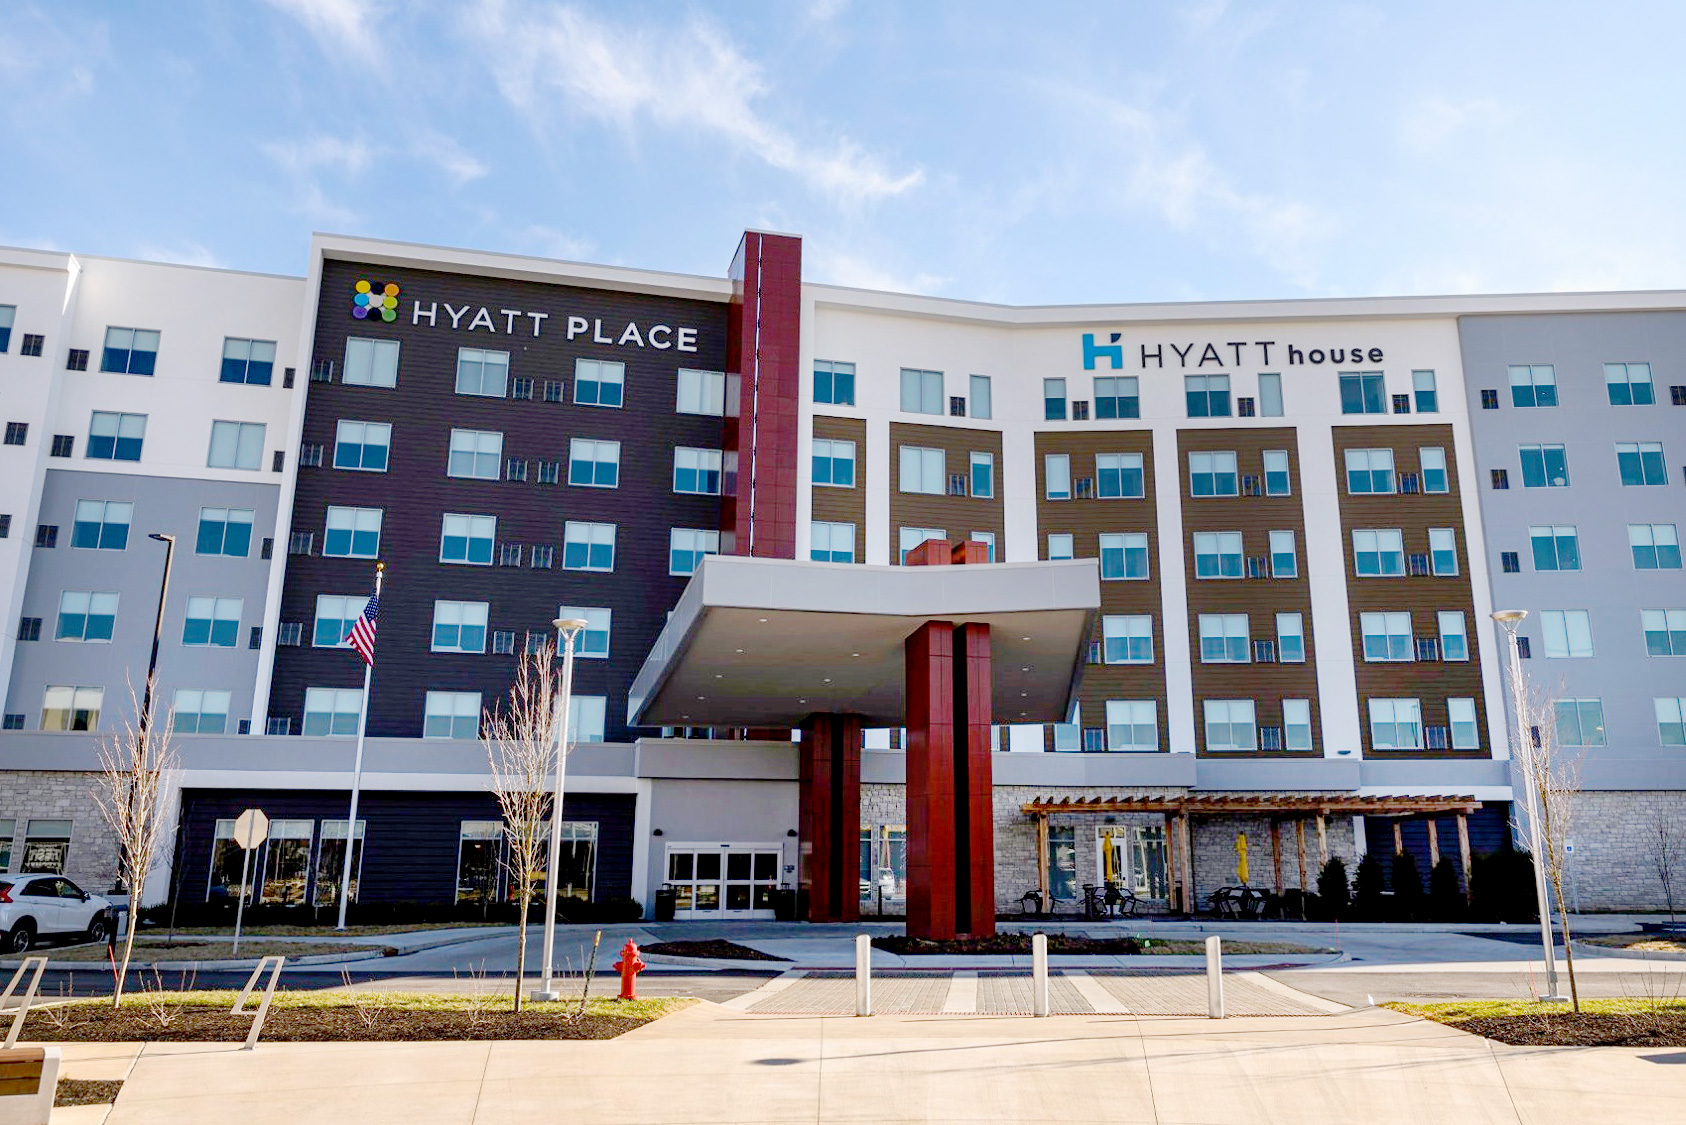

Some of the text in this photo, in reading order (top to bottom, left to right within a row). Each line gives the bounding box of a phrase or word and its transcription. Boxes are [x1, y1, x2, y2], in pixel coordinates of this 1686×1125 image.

[412, 300, 699, 353] HYATT PLACE
[1140, 341, 1385, 369] HYATT house
